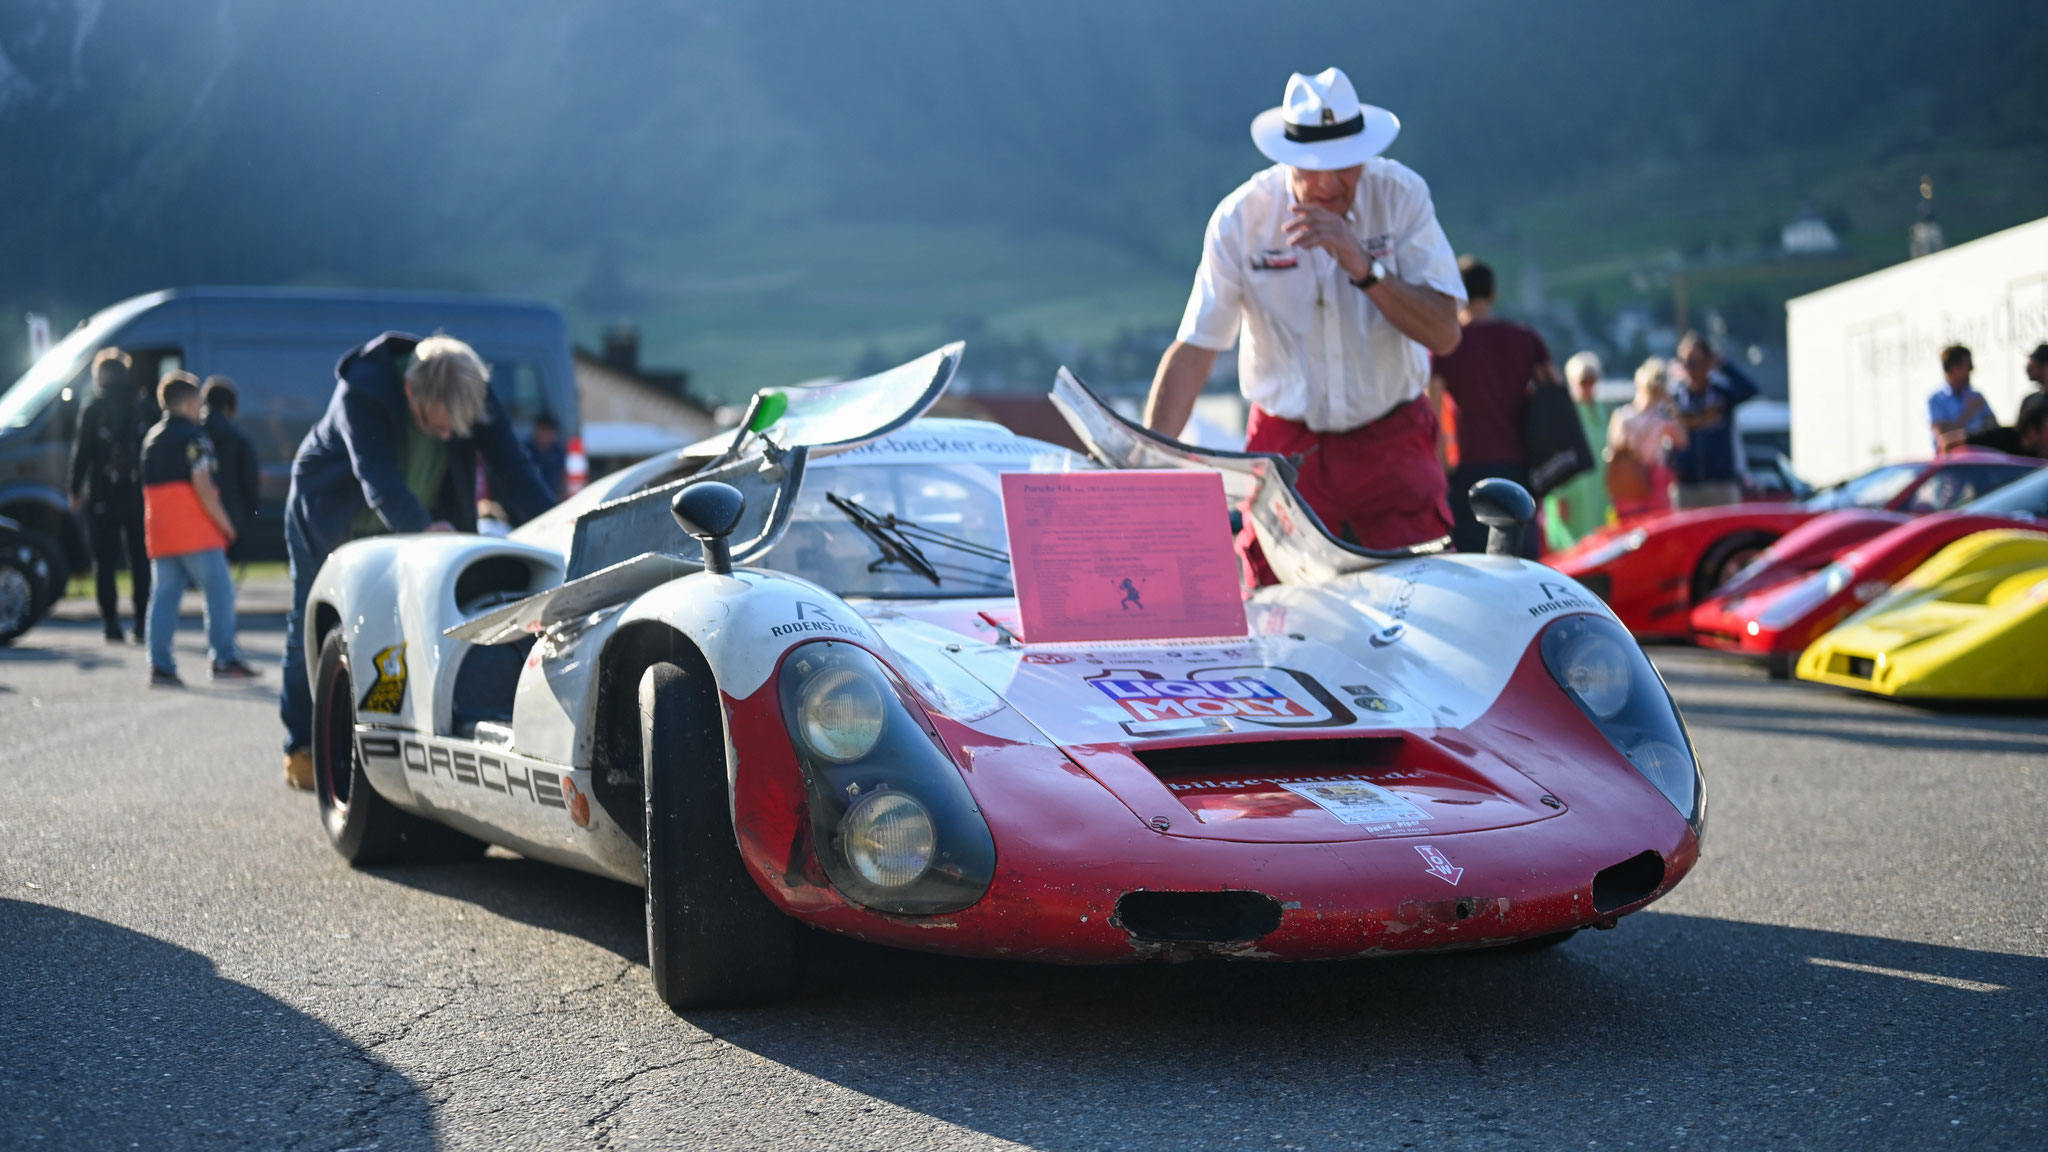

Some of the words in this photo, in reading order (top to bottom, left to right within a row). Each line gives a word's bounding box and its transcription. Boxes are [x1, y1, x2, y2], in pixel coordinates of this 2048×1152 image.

[770, 621, 867, 640] RODENSTOCK
[1099, 680, 1278, 699] LIQUI
[1126, 698, 1297, 721] MOLY
[359, 737, 567, 809] PORSCHE
[1365, 823, 1392, 833] David
[1397, 820, 1420, 830] Piper
[1421, 846, 1453, 875] TOW
